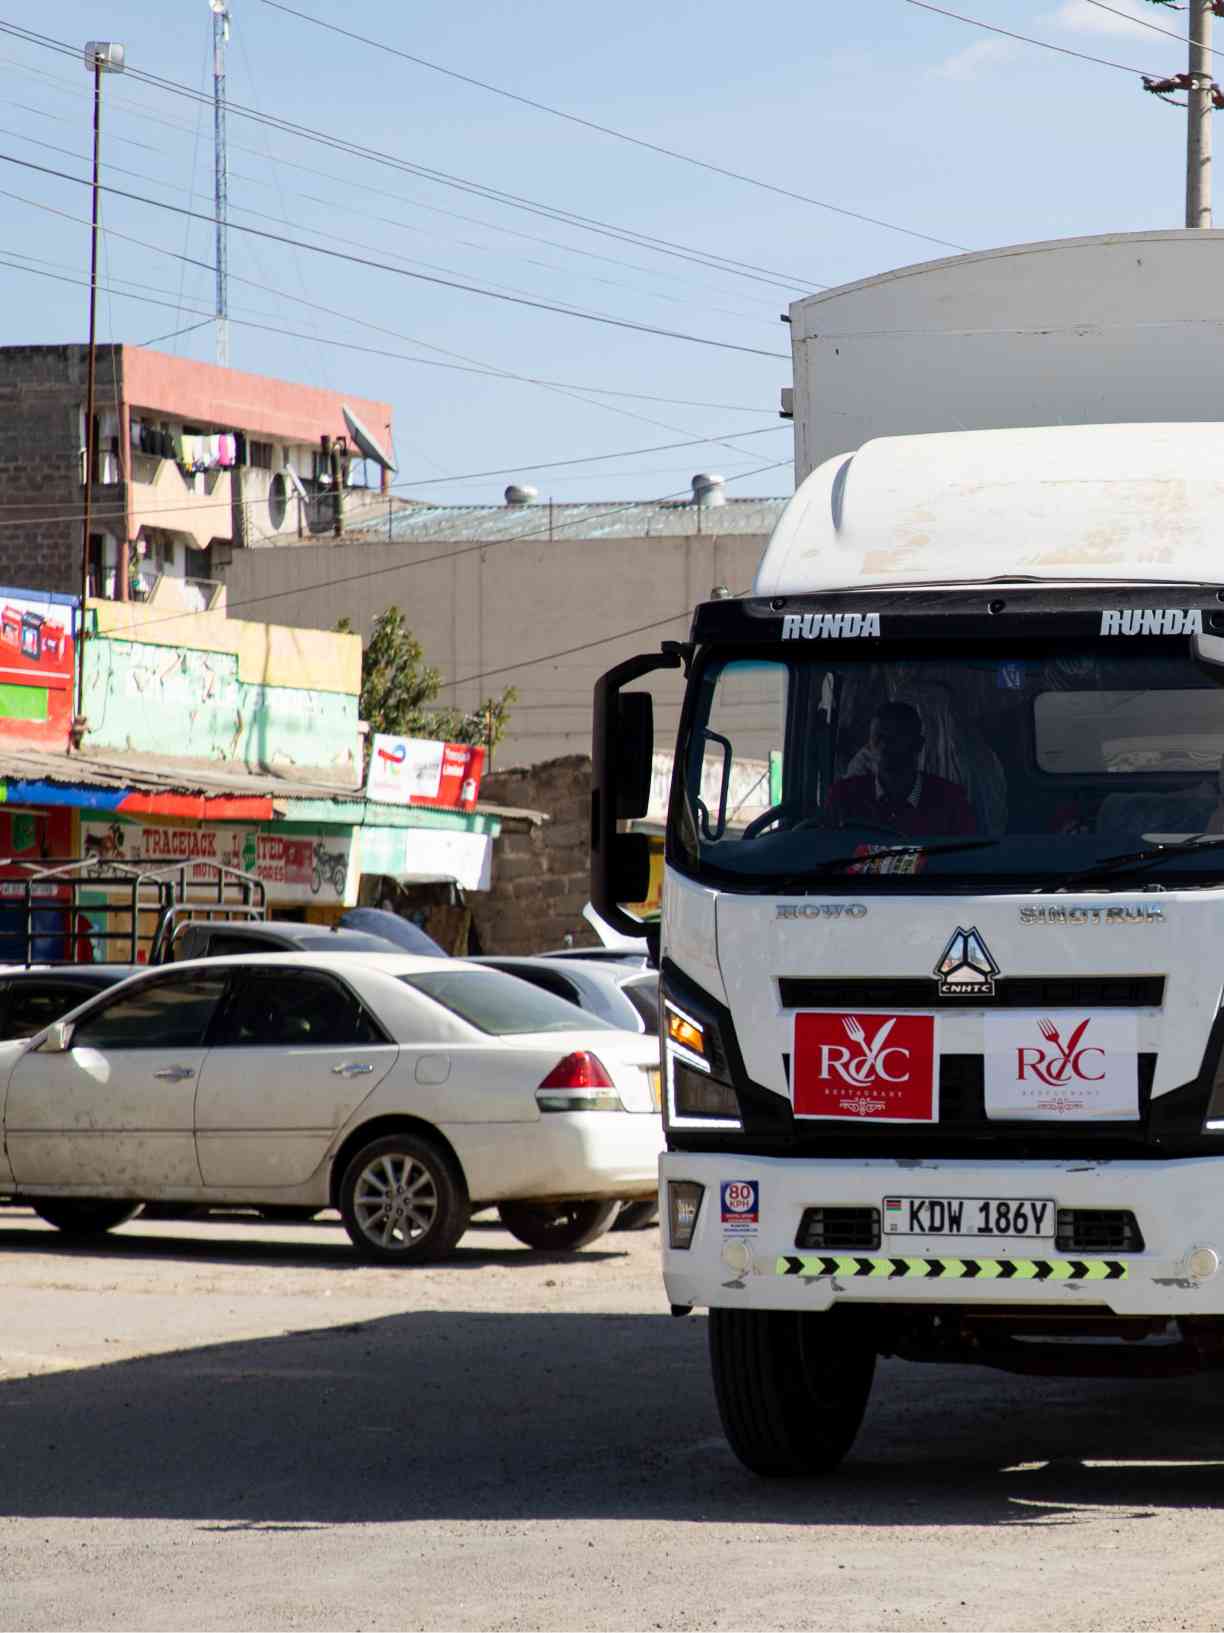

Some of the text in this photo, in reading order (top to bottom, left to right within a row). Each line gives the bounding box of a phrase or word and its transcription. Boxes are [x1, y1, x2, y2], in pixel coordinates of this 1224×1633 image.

[782, 612, 882, 640] RUNDA
[1100, 609, 1203, 636] RUNDA
[142, 829, 217, 858] TRACEJACK
[775, 902, 869, 922] HOWO
[1018, 902, 1168, 927] SINOTRUK
[941, 983, 991, 995] CNHTC
[729, 1184, 751, 1200] 80
[729, 1200, 750, 1209] KPH
[909, 1200, 1048, 1235] KDW 186Y
